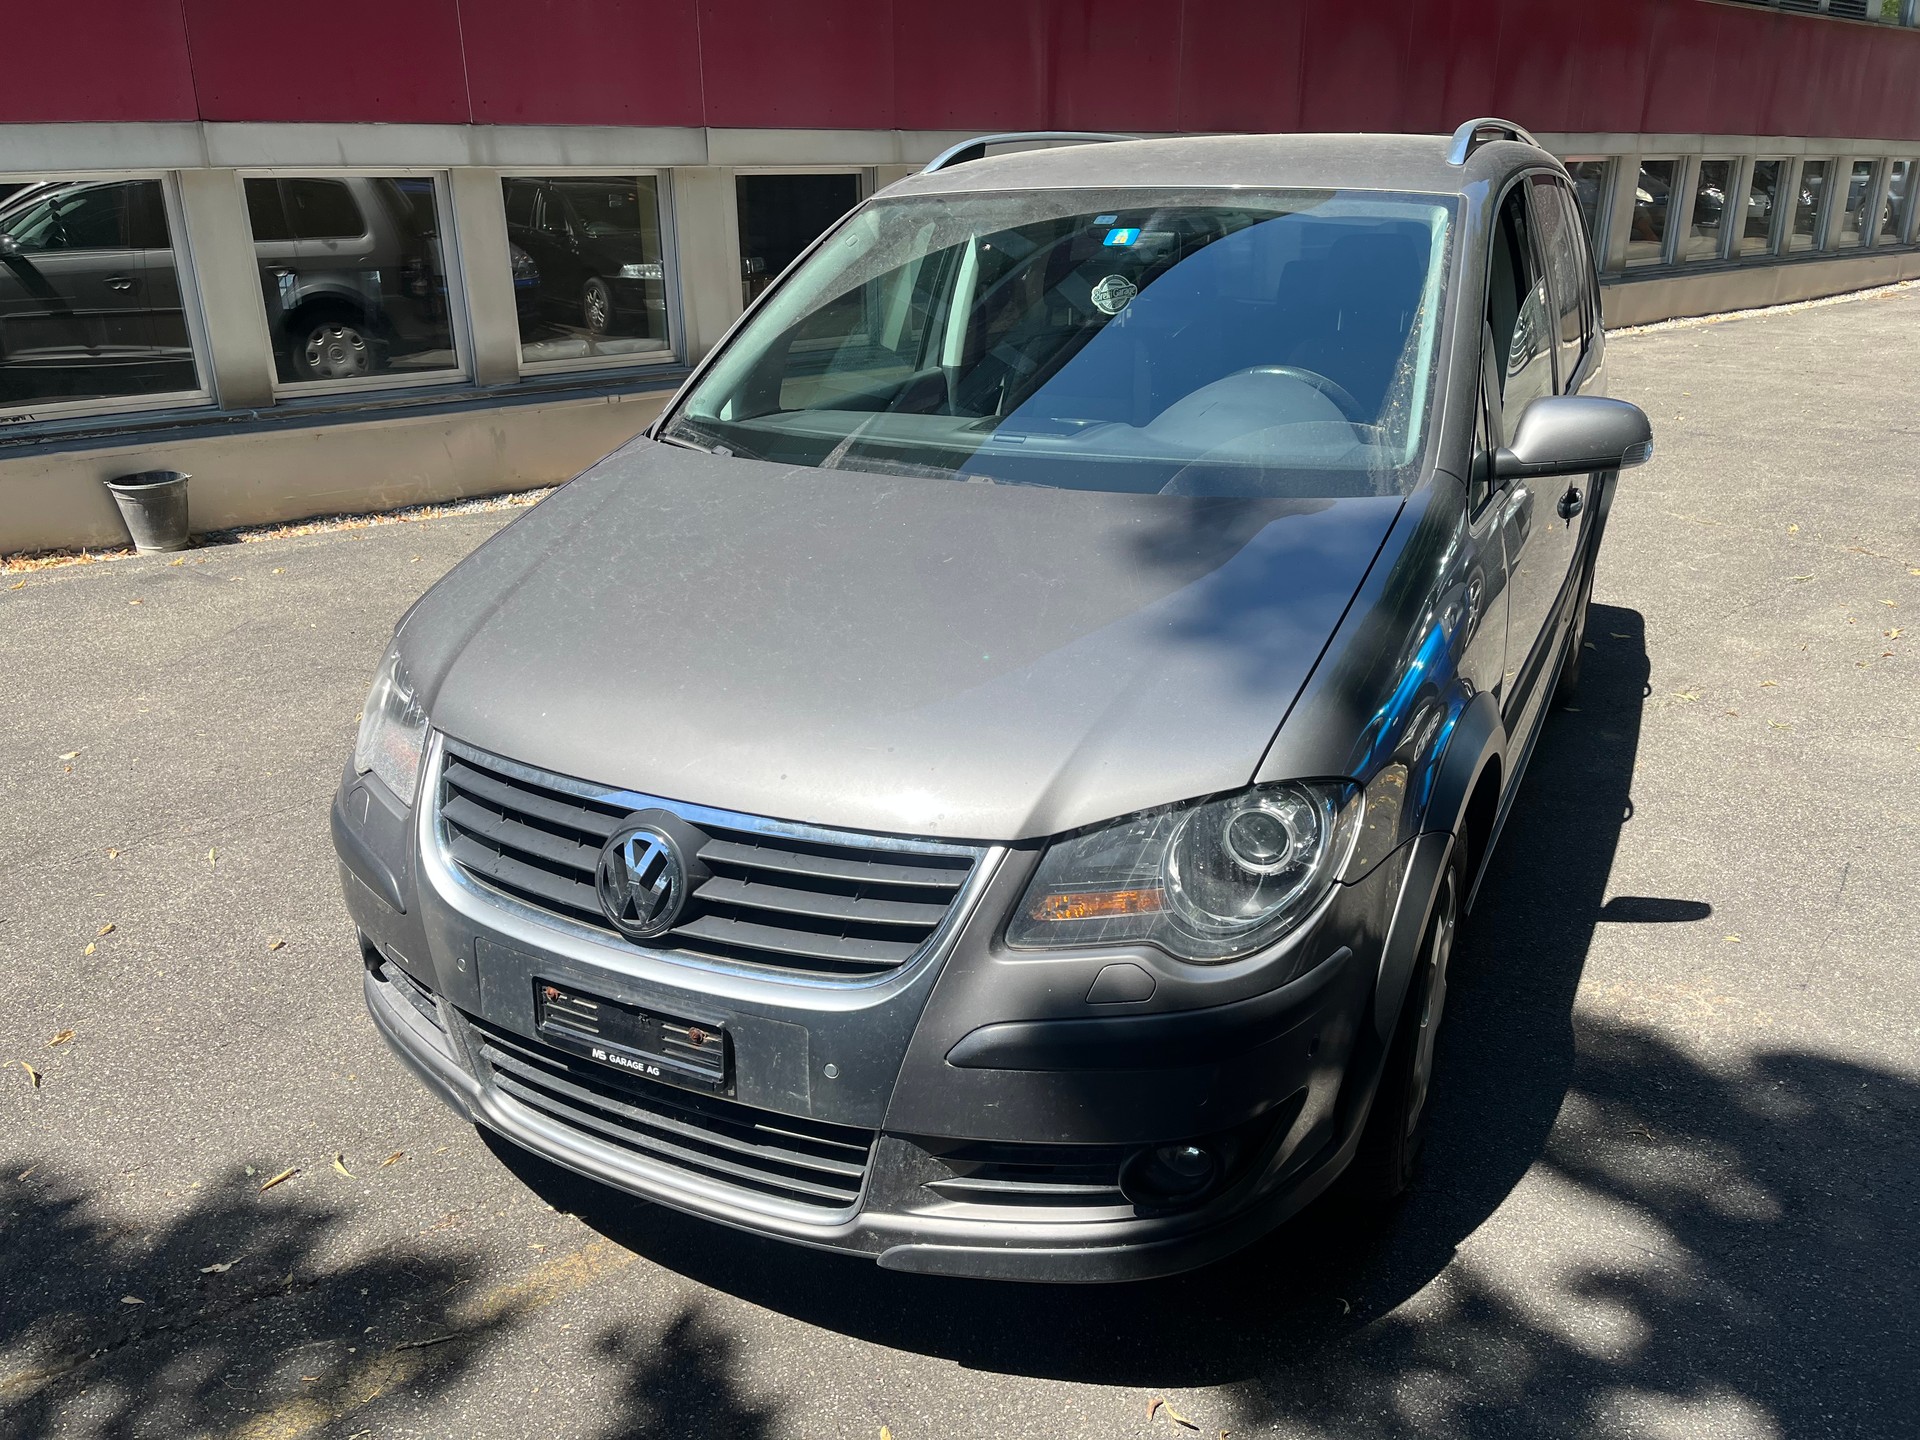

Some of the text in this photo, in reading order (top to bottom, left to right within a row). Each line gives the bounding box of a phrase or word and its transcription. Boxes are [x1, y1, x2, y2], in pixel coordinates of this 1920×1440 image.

[1113, 286, 1135, 298] Garage
[601, 830, 680, 933] VW
[592, 1048, 660, 1076] MS GARAGE AG
